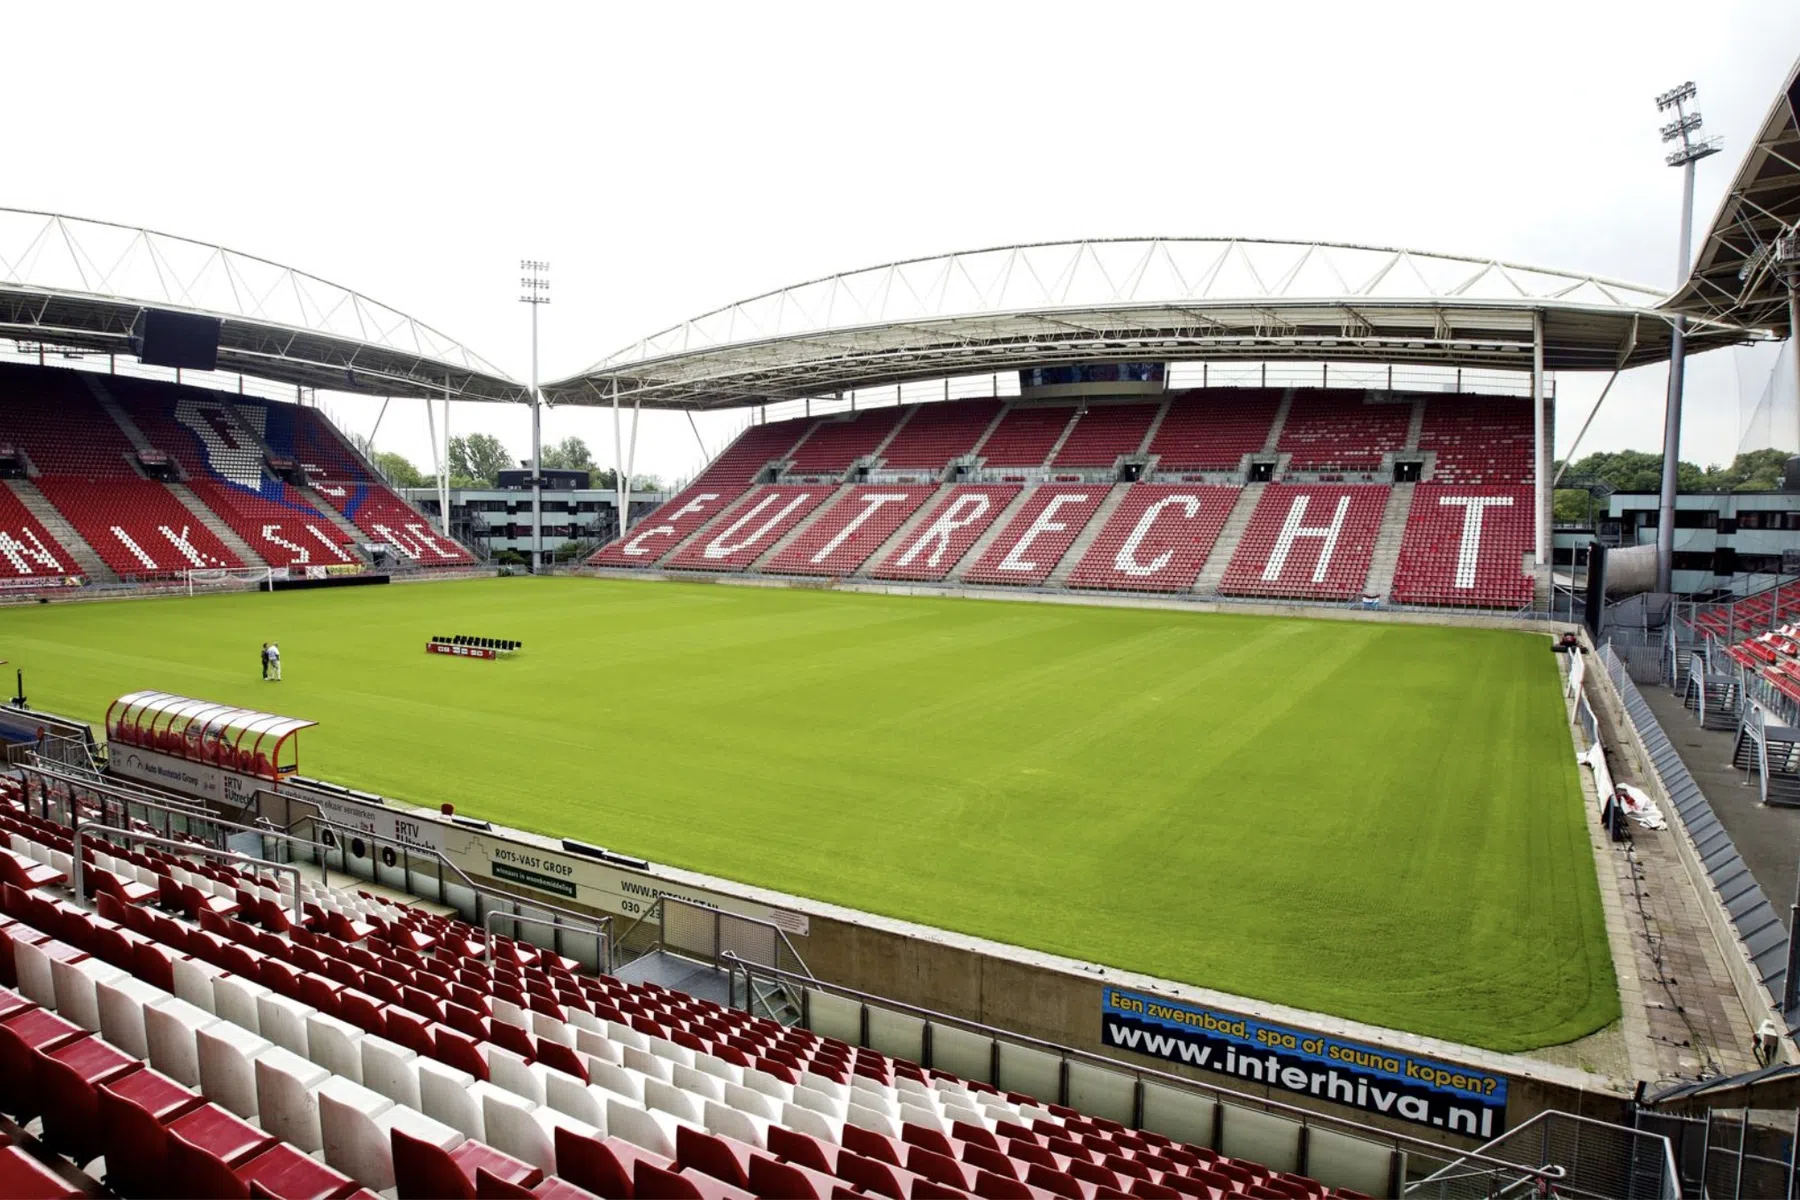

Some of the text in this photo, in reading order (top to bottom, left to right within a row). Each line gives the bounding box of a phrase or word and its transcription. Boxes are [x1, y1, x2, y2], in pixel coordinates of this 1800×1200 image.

[704, 493, 1516, 591] UTRECHT
[228, 776, 243, 790] RTV
[400, 821, 420, 838] RTV
[495, 848, 573, 877] ROTS-VAST GROEP
[621, 900, 640, 914] 030
[1110, 992, 1497, 1097] Een zwembad, spa of sauna kopen?
[1109, 1022, 1493, 1139] www.interhiva.nl
